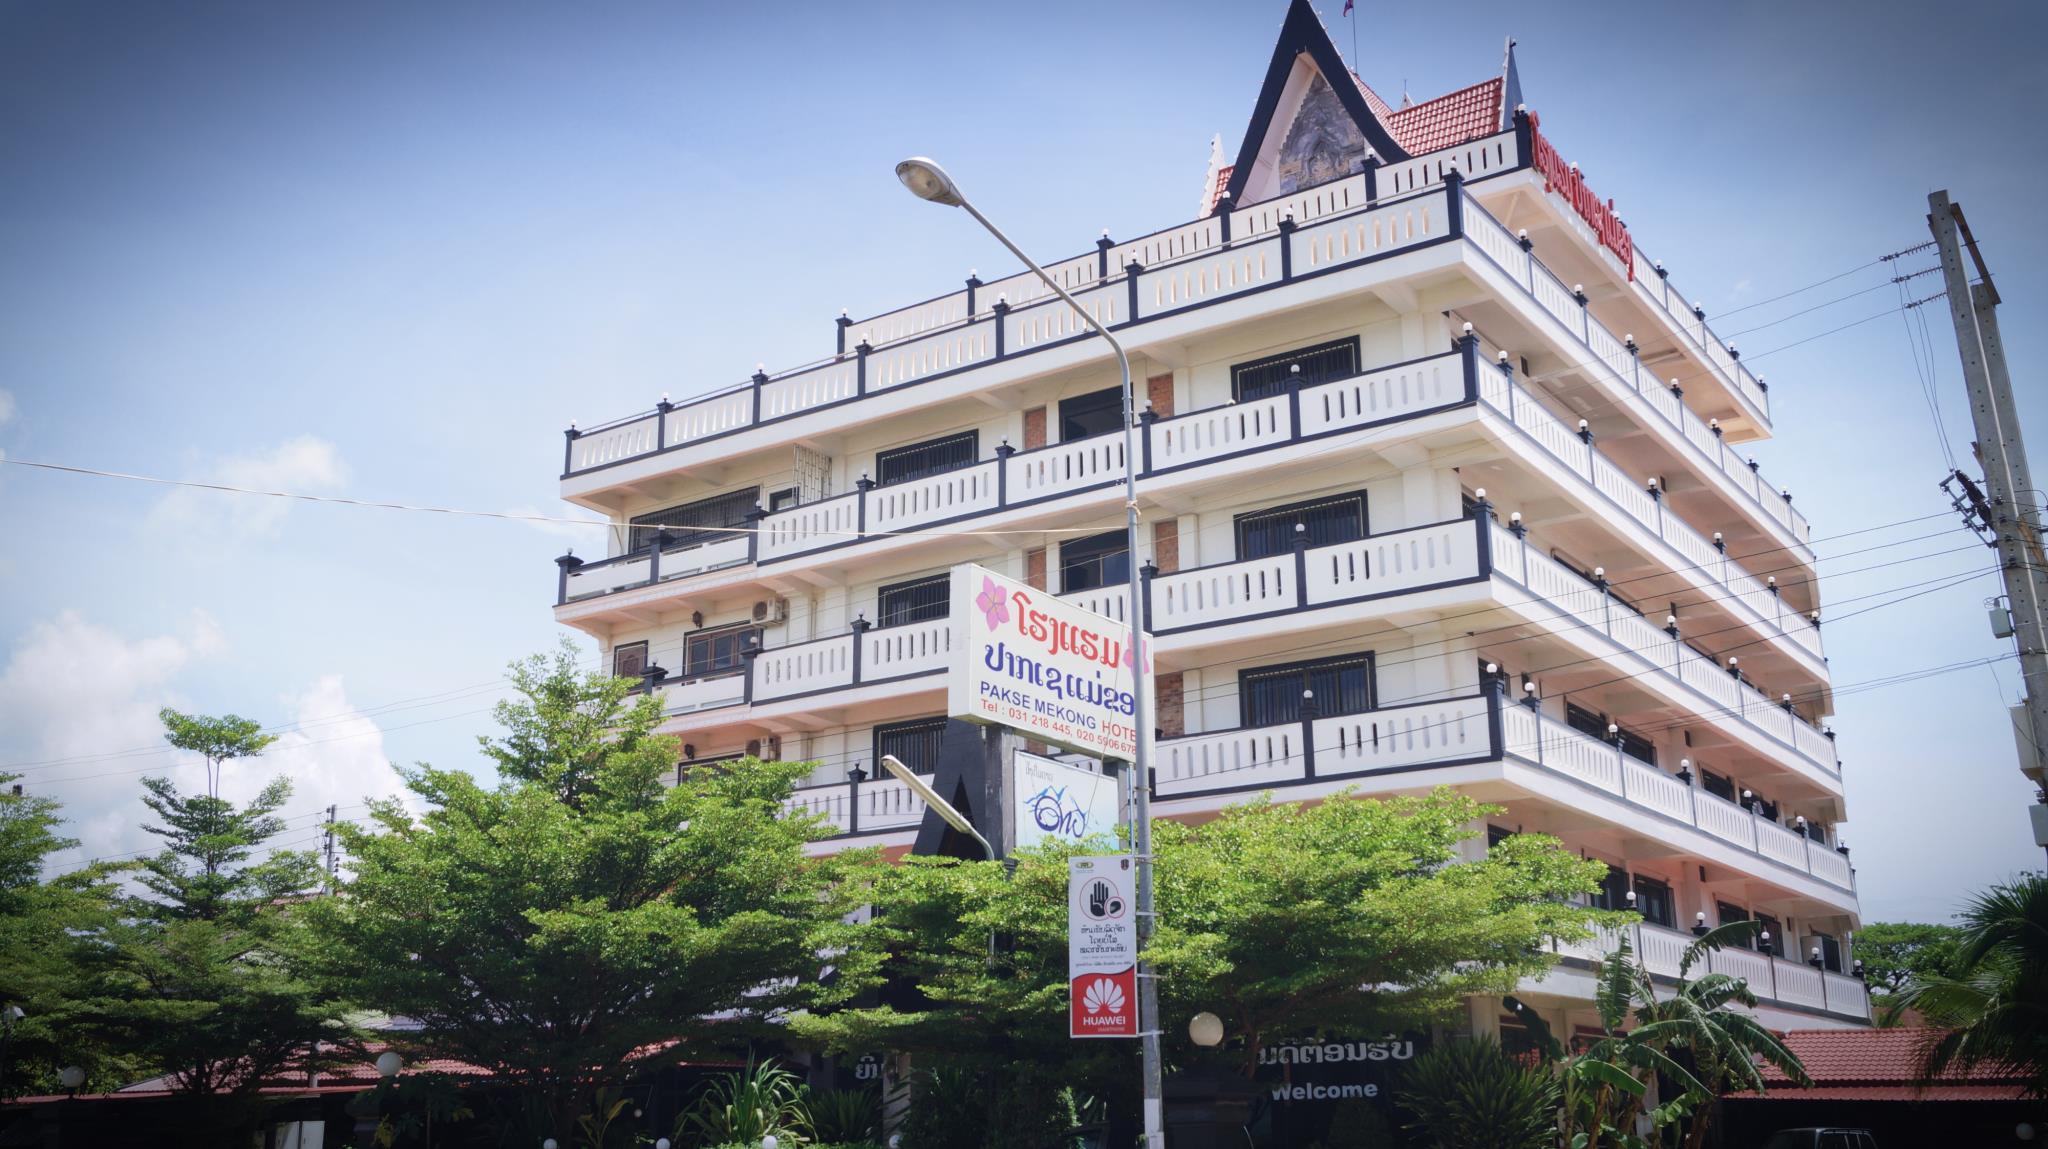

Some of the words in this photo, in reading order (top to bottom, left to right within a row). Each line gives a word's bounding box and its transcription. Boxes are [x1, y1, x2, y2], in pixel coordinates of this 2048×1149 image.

[1012, 591, 1120, 668] ໂຮງແຮມ
[984, 642, 1136, 716] ປາກເຊແມ່ຂອ
[980, 680, 1030, 710] PAKSE
[1035, 699, 1096, 729] MEKONG
[1101, 720, 1136, 743] HOTE
[981, 699, 998, 713] Tel
[1008, 707, 1027, 722] 031
[1032, 714, 1049, 729] 218
[1052, 722, 1073, 737] 445,
[1076, 728, 1094, 743] 020
[1120, 742, 1136, 756] 678
[1082, 1016, 1126, 1026] HUAWEI
[1271, 1082, 1379, 1101] Welcome
